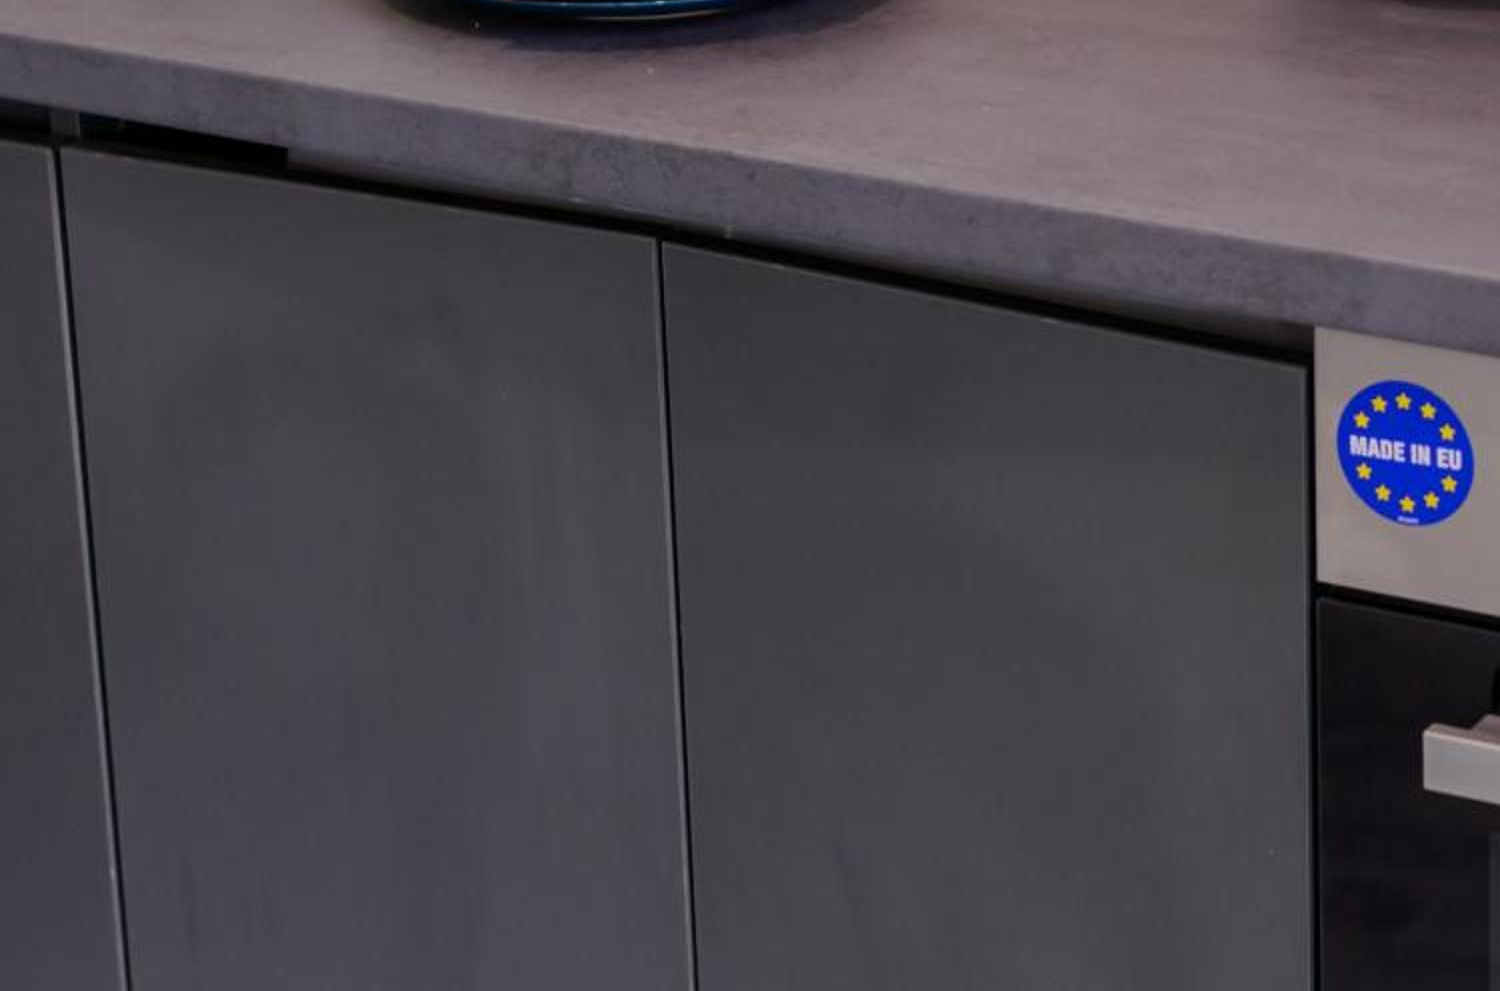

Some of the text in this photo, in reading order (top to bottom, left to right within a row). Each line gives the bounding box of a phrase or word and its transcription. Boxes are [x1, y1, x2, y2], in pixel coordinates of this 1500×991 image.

[1349, 435, 1462, 471] MADE IN EU
